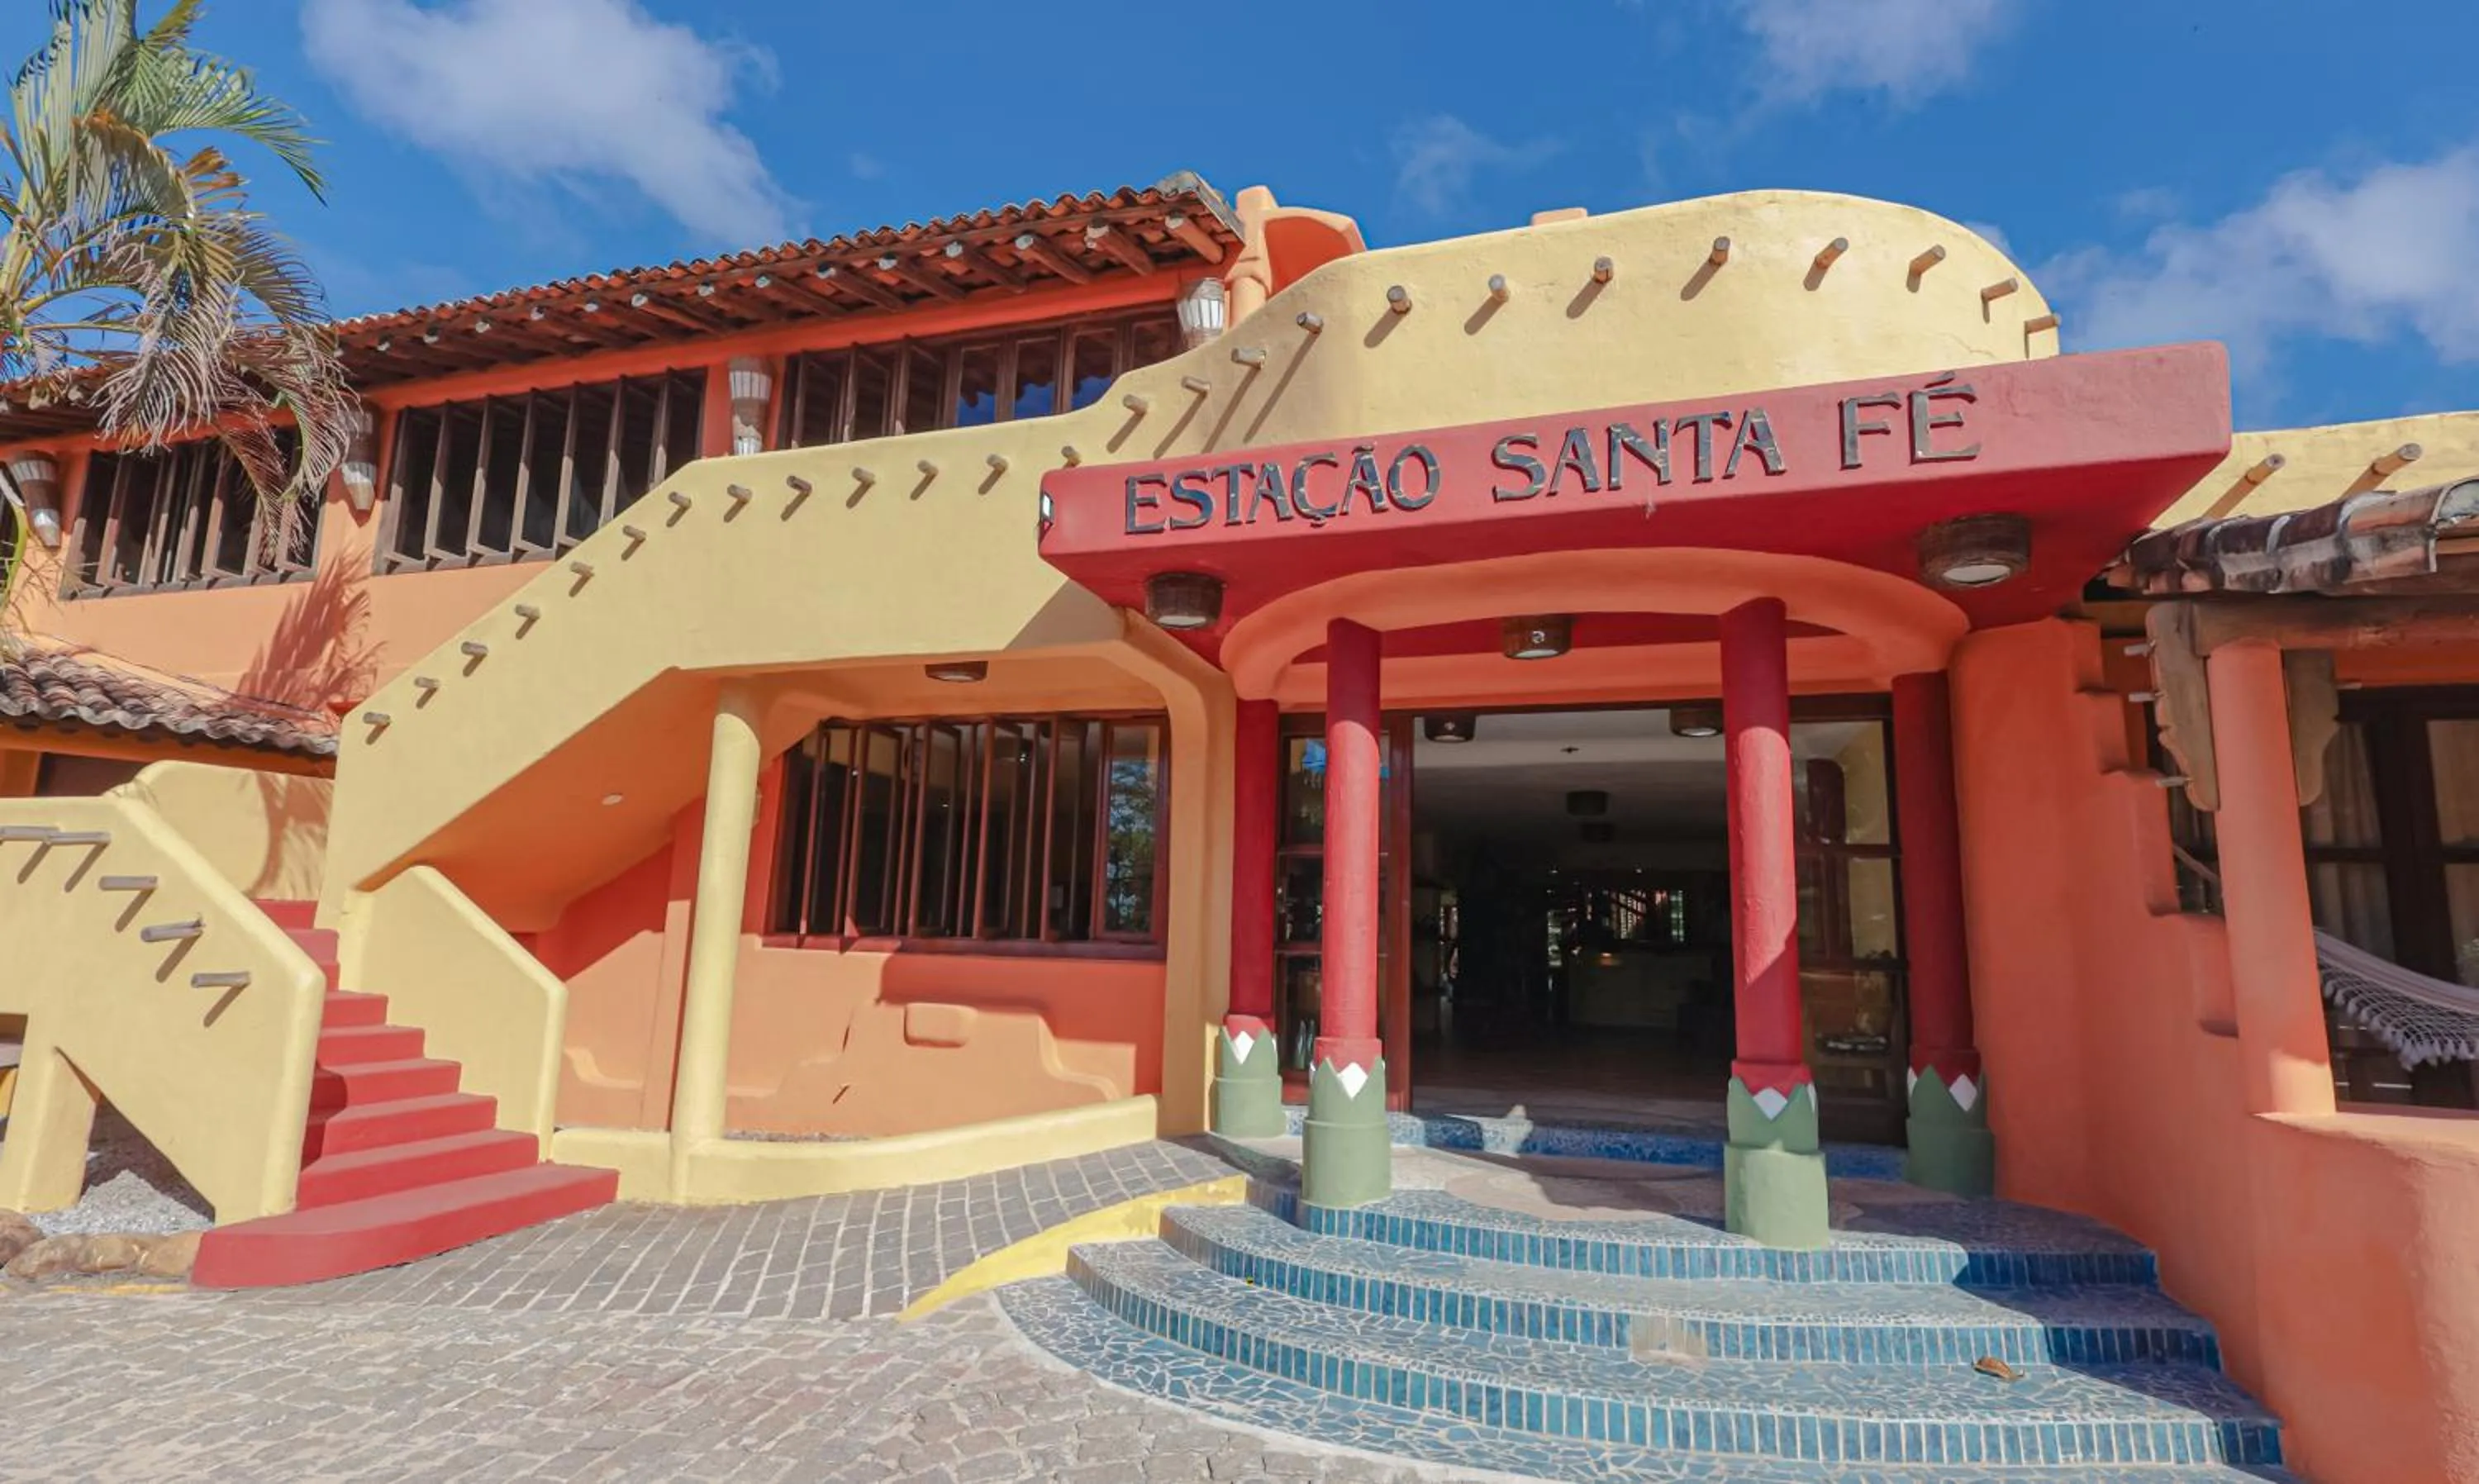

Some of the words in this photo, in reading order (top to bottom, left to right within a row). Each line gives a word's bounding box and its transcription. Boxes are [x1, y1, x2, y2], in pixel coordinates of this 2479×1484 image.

[1125, 444, 1440, 535] ESTAÇÃO
[1492, 407, 1787, 502] SANTA
[1838, 370, 1981, 470] FÉ
